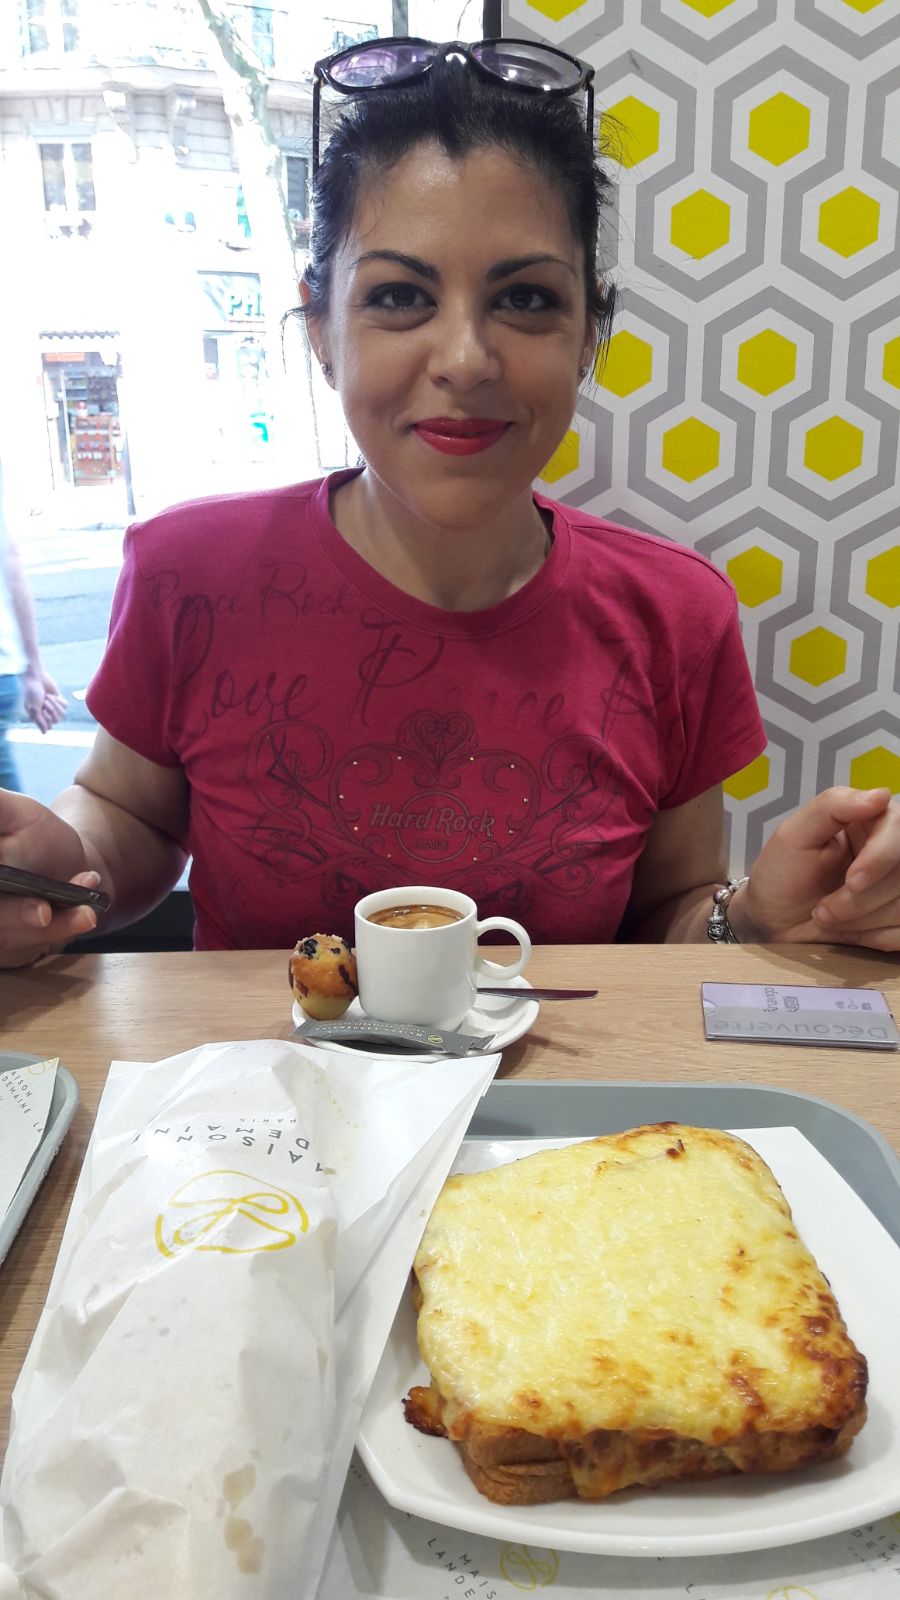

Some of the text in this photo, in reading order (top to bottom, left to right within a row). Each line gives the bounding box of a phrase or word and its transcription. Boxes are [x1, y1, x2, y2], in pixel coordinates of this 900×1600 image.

[228, 293, 265, 317] PH
[369, 800, 495, 837] Hard Rock
[713, 1020, 889, 1039] Découverte
[0, 1074, 32, 1114] DEMAINE
[10, 1071, 33, 1098] AISON
[130, 1125, 310, 1151] DEMAIN
[427, 1537, 476, 1598] LANDE
[459, 1553, 497, 1599] MAIS
